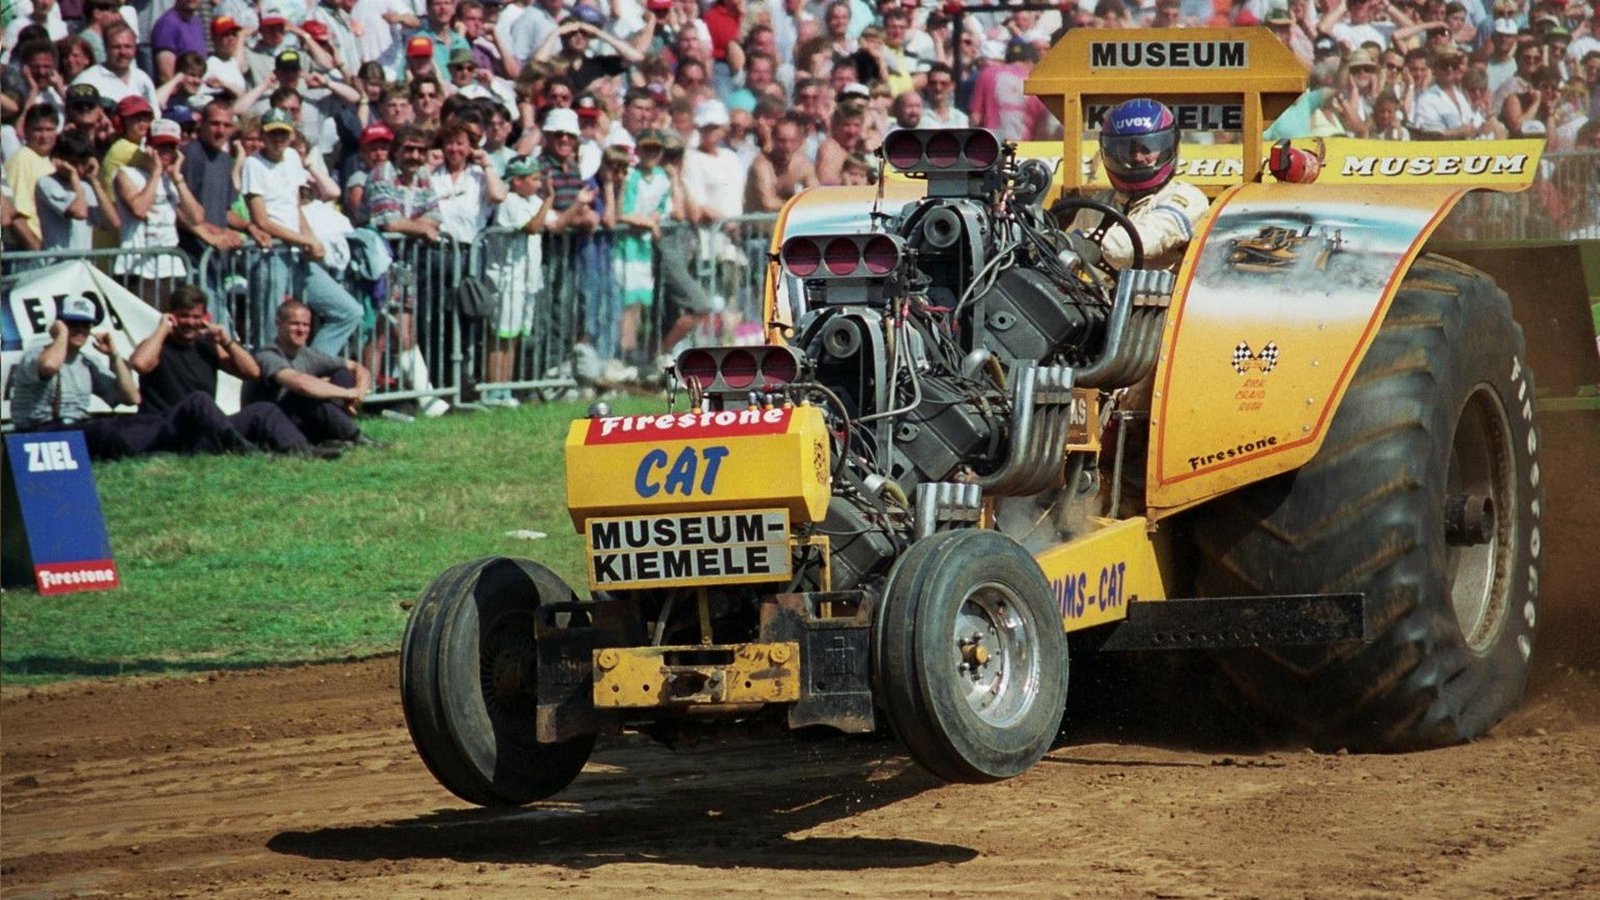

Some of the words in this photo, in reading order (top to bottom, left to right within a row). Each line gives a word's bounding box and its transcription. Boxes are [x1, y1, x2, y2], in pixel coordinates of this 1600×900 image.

[1092, 42, 1245, 67] MUSEUM
[1088, 105, 1243, 130] KELE
[1116, 116, 1153, 129] uvex
[1340, 154, 1527, 176] MUSEUM
[599, 408, 785, 436] Firestone
[23, 441, 79, 472] ZIEL
[1187, 435, 1277, 471] Firestone
[635, 446, 729, 498] CAT
[591, 514, 784, 550] MUSEUM-
[593, 546, 770, 583] KIEMELE
[38, 569, 115, 589] Firestone
